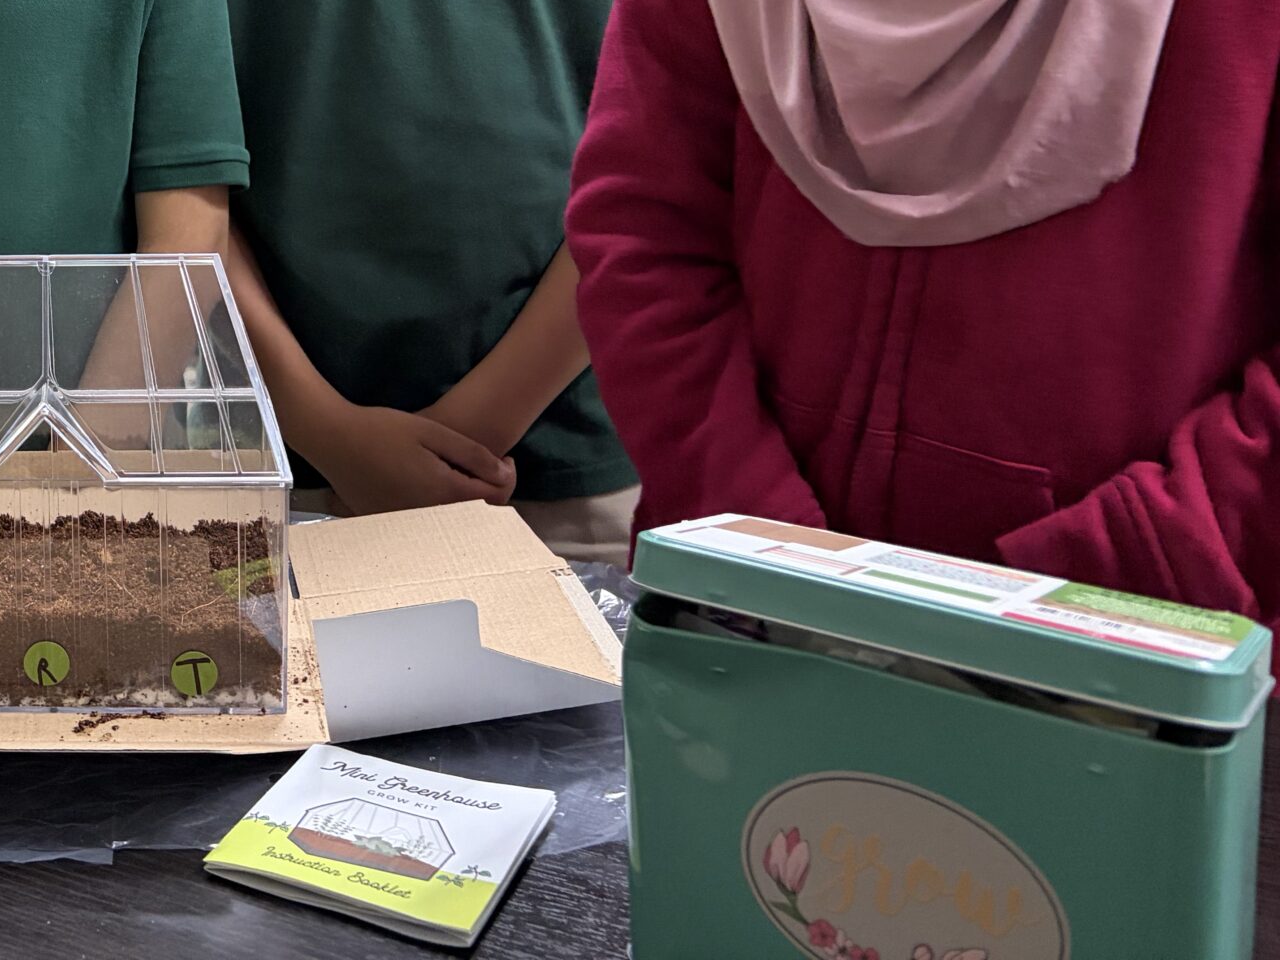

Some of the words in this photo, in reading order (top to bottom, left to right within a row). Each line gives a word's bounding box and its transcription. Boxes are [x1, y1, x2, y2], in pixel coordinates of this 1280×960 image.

[36, 656, 59, 688] R
[175, 656, 212, 697] T
[319, 761, 378, 782] Mini
[376, 775, 503, 811] Greenhouse
[366, 789, 411, 804] GROW
[414, 801, 439, 812] KIT
[260, 845, 342, 878] Instruction
[346, 870, 412, 900] Booklet
